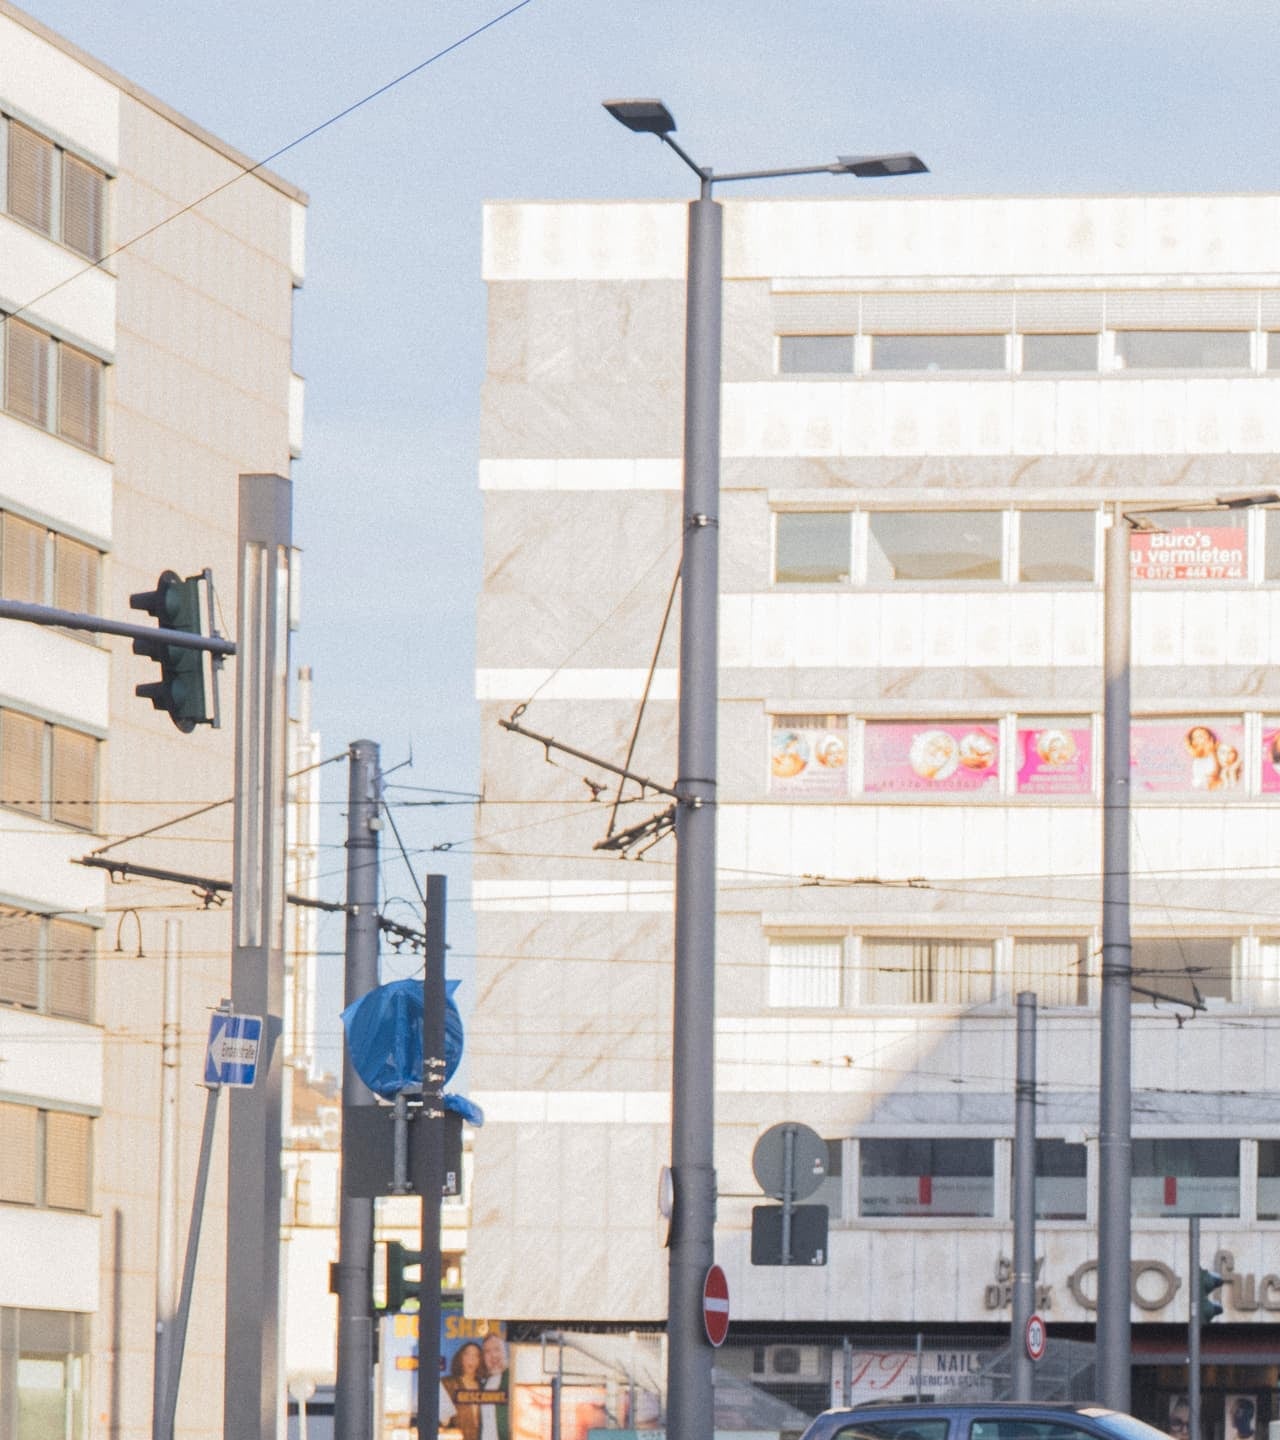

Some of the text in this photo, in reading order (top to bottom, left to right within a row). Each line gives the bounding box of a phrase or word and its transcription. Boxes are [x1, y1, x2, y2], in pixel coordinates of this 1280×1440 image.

[1147, 547, 1242, 563] vermieten
[985, 1285, 1053, 1310] OPK
[1030, 1327, 1041, 1348] 30
[936, 1353, 986, 1373] NAILS
